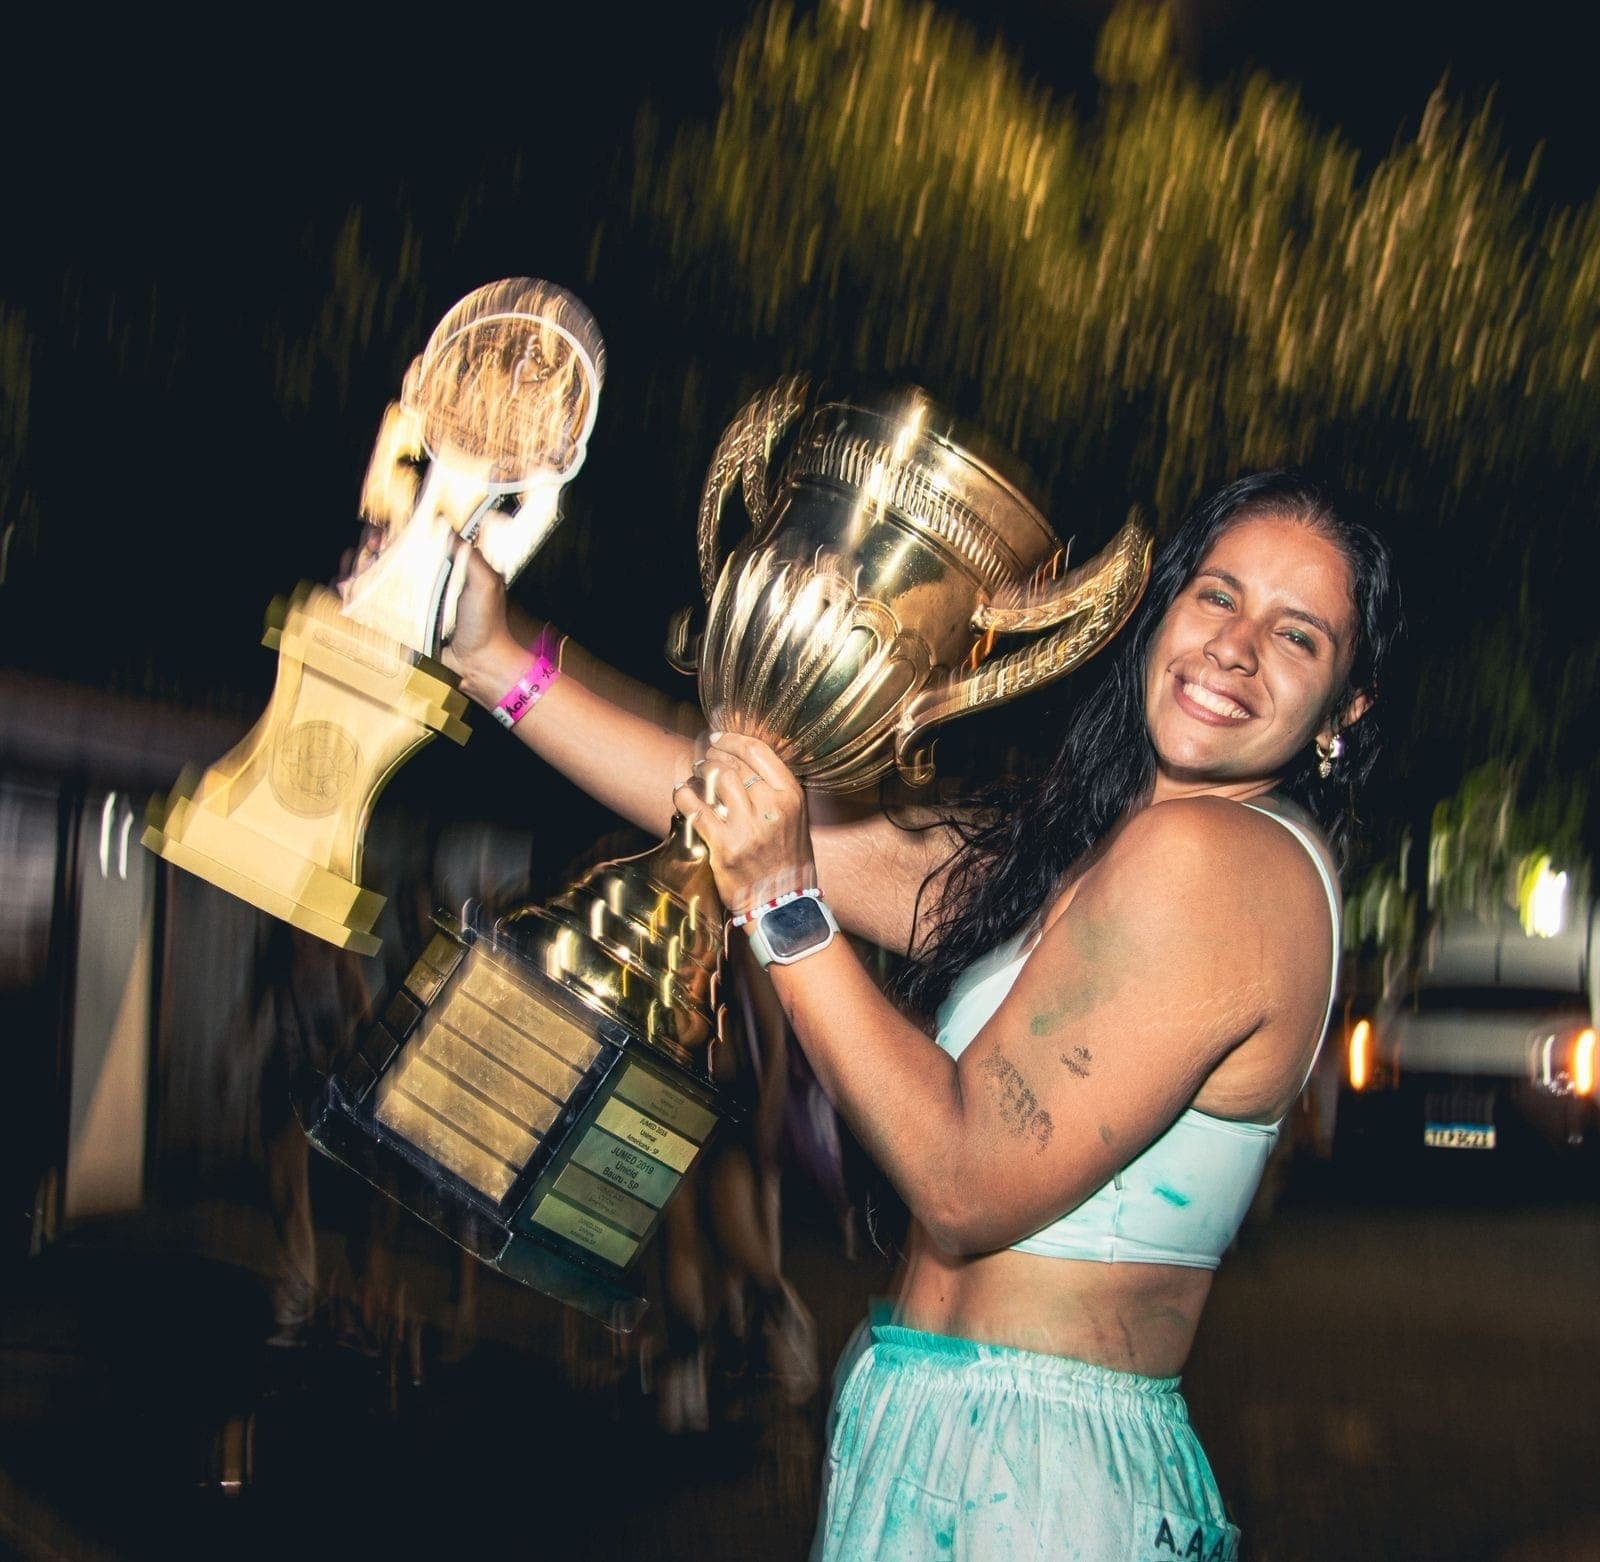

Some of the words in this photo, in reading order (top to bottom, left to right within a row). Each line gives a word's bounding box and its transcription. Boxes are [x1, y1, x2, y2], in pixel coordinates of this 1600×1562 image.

[611, 1147, 637, 1164] JUMED
[603, 1167, 623, 1183] Bauru
[627, 1181, 639, 1190] SP
